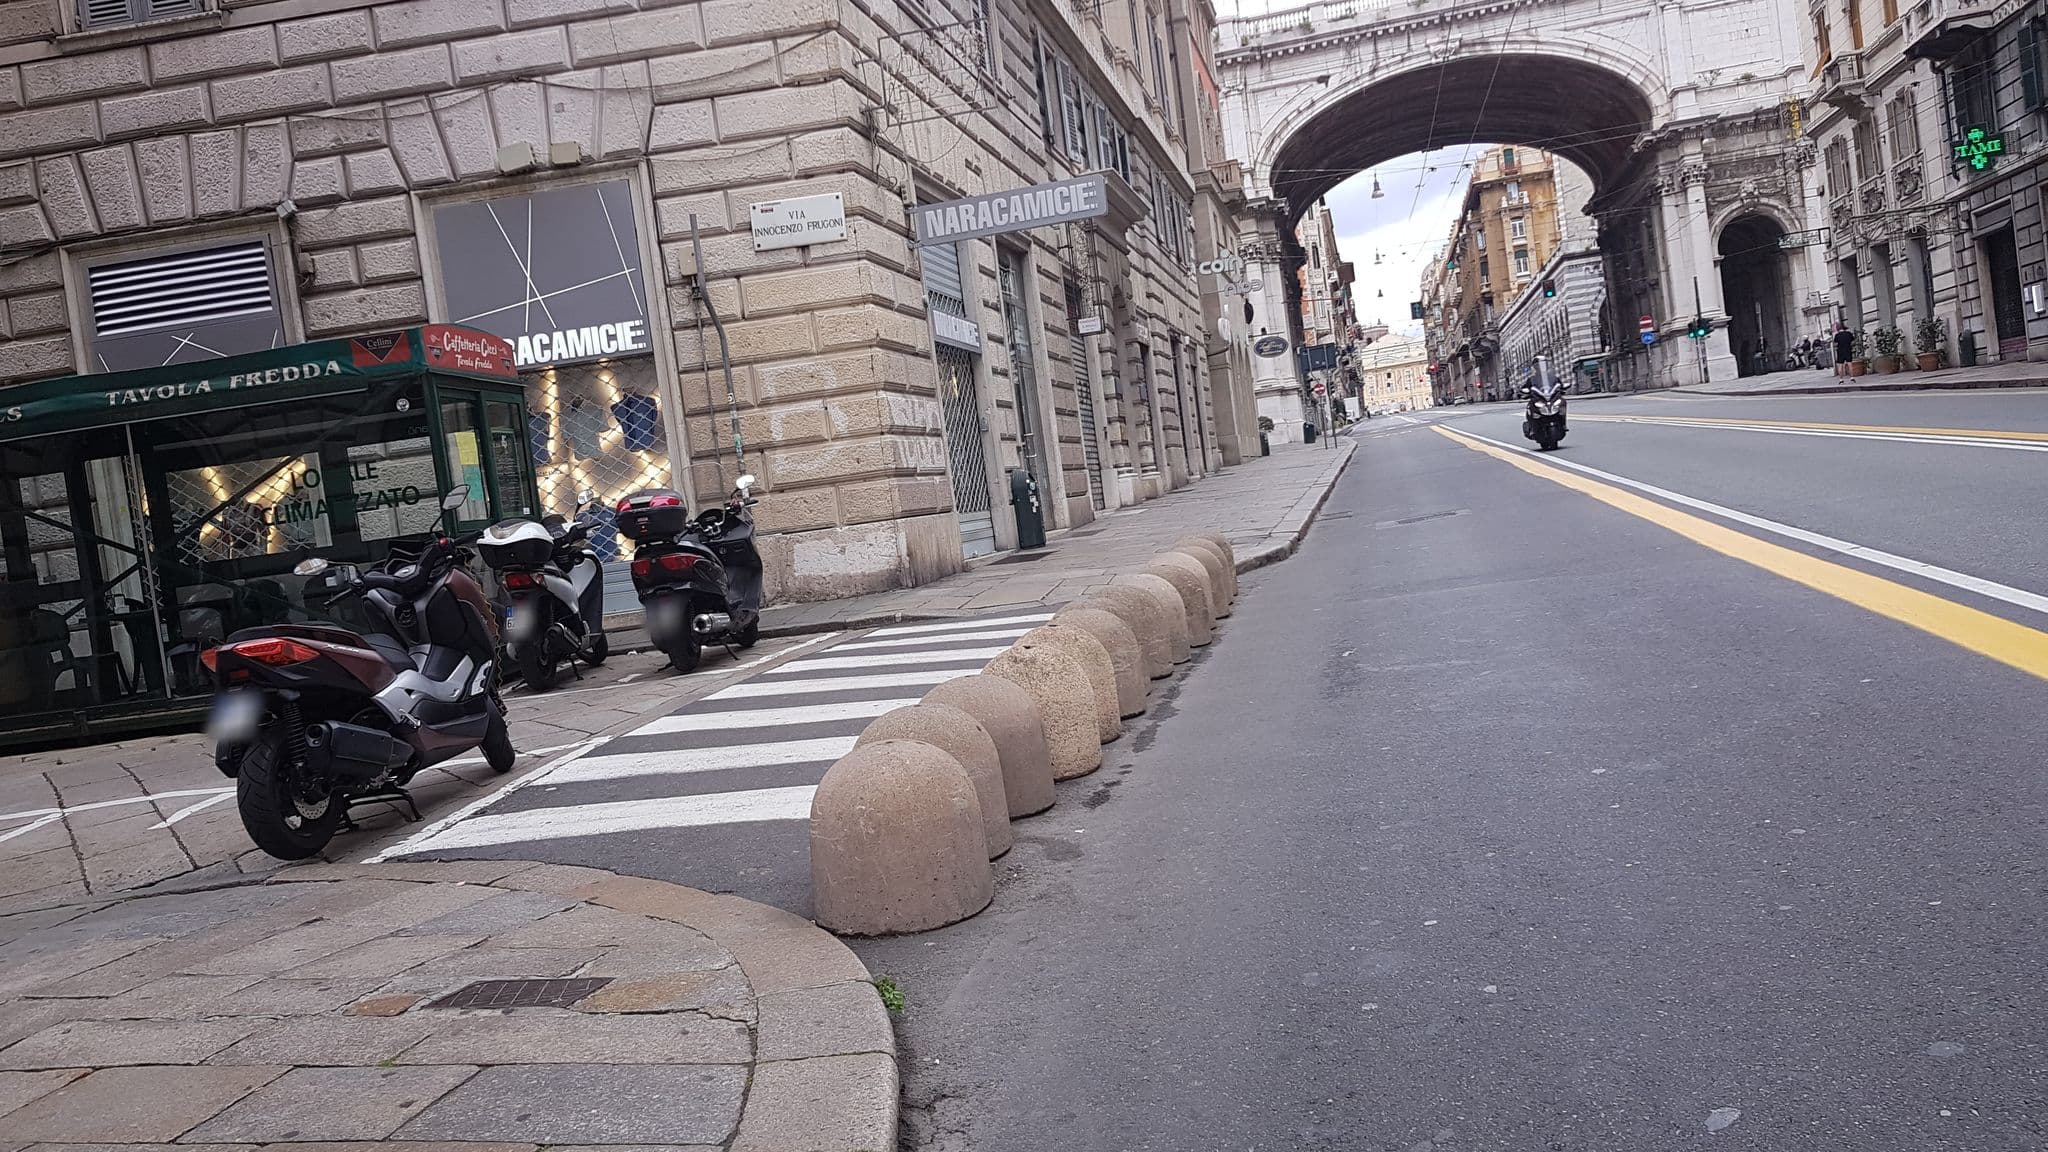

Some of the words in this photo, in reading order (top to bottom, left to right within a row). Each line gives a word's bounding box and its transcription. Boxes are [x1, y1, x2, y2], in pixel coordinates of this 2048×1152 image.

[788, 210, 806, 220] VIA
[924, 181, 1099, 239] NARACAMICIE
[754, 223, 803, 238] INNOCENZO
[806, 217, 844, 231] FRUGONI
[1199, 249, 1245, 275] coin
[443, 331, 481, 353] Caffetteria
[104, 379, 212, 406] TAVOLA
[229, 360, 342, 389] FREDDA
